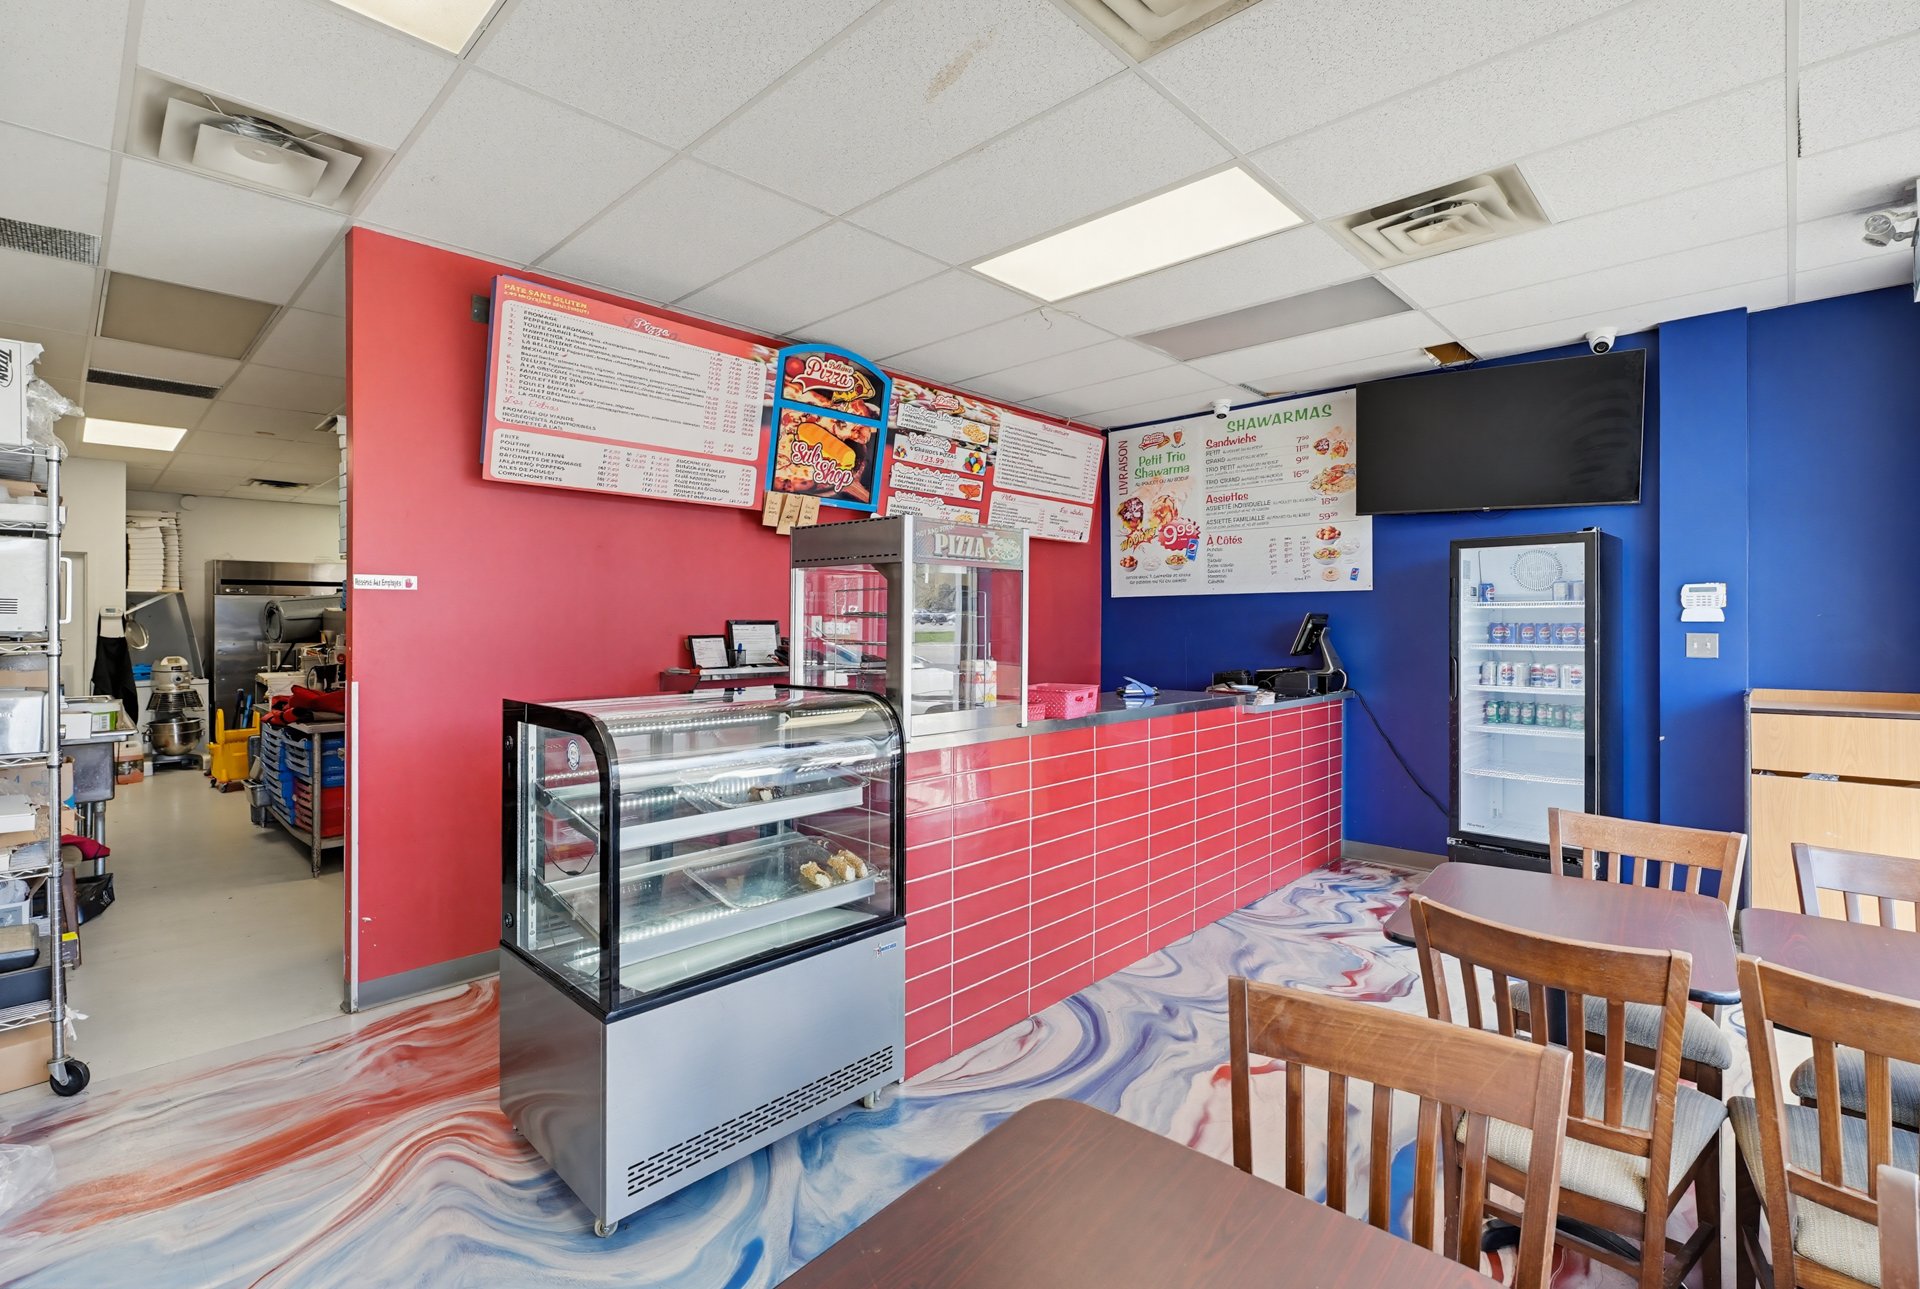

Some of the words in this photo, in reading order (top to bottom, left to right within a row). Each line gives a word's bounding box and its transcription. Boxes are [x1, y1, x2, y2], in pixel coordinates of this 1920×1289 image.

[528, 290, 552, 300] SANS
[553, 296, 587, 309] GLUTEN
[524, 311, 557, 321] FROMAGE
[634, 317, 670, 337] Pizza
[807, 359, 850, 386] Pizza
[1226, 404, 1333, 433] SHAWARMAS
[1205, 433, 1257, 450] Sandwichs
[793, 442, 821, 465] Sub
[1138, 454, 1162, 467] Petit
[1166, 451, 1186, 463] Trio
[815, 460, 852, 491] Shop
[1118, 440, 1128, 496] LIVRAISON
[1134, 464, 1190, 480] Shawarma
[933, 533, 986, 560] PIZZA
[1216, 535, 1243, 545] Côtés
